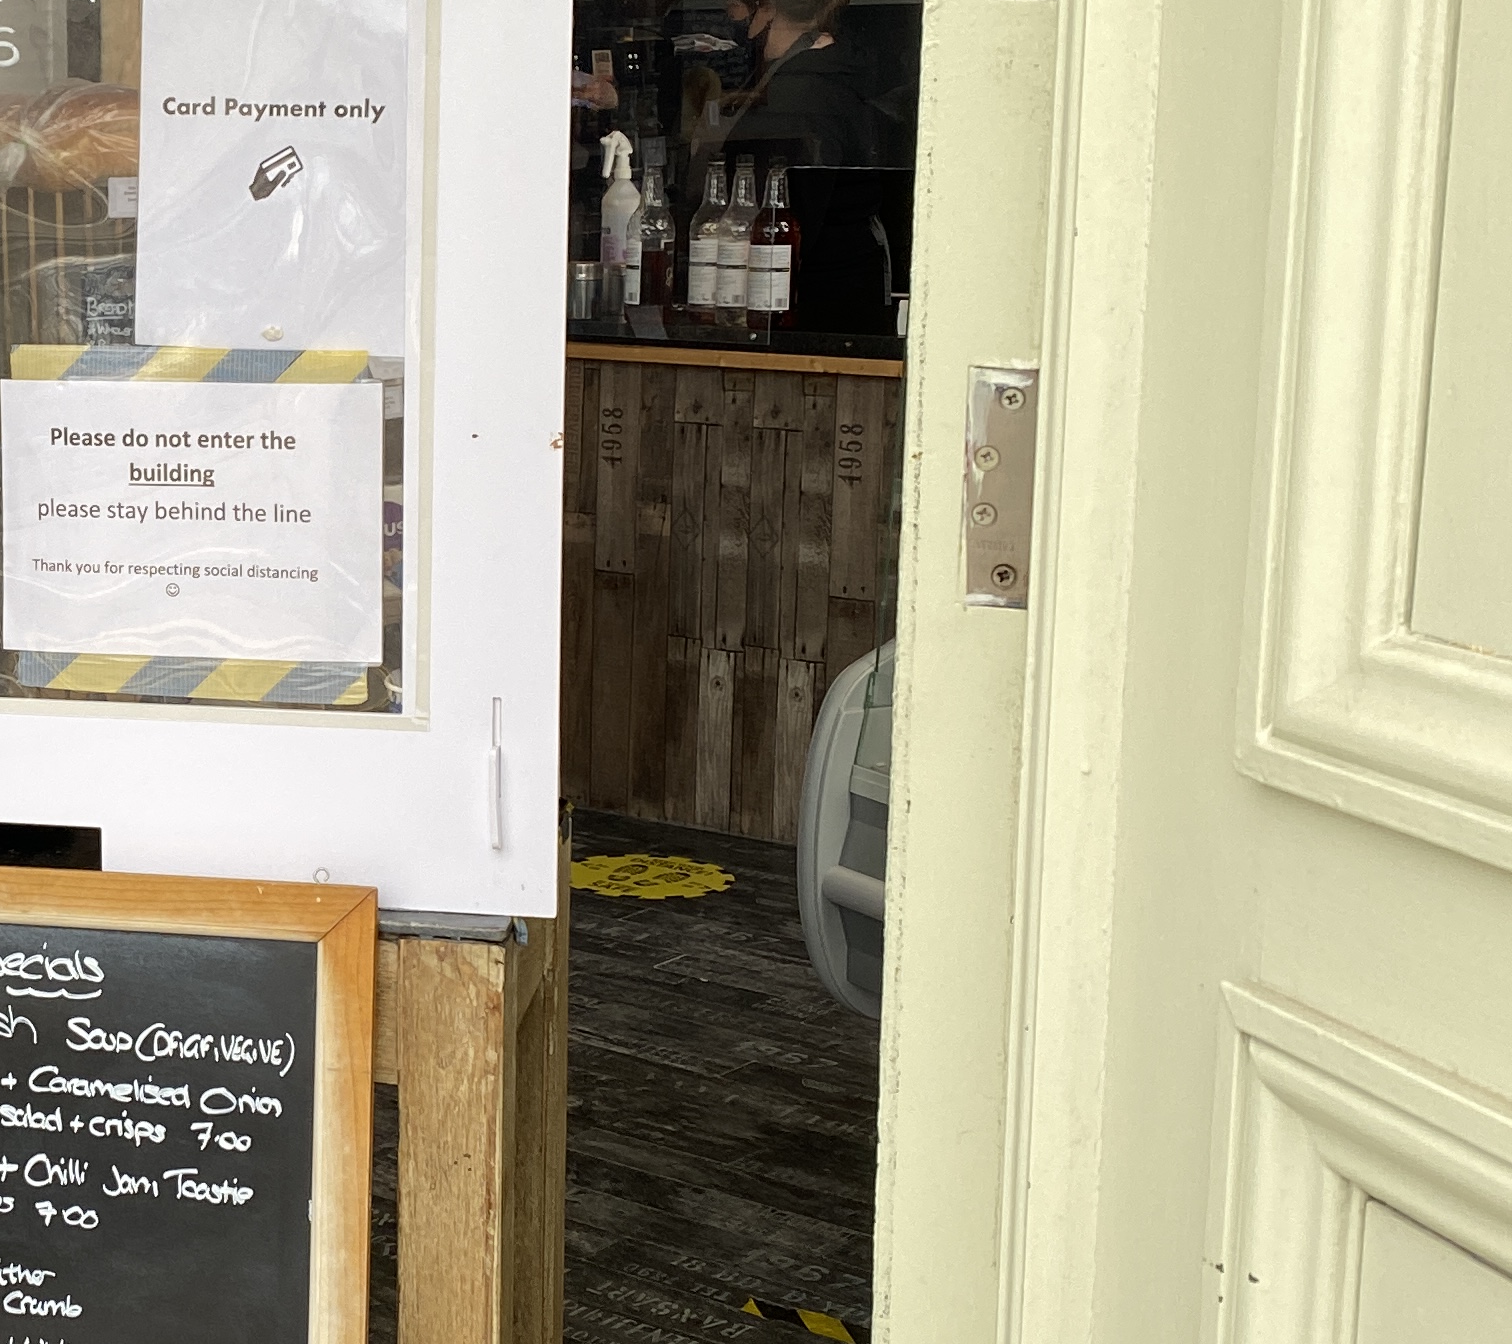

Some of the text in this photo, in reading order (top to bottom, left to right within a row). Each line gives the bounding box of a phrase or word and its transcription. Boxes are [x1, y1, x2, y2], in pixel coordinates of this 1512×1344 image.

[162, 97, 386, 123] Card Payment only
[50, 428, 296, 451] Please do not enter the
[601, 408, 623, 469] 1958
[838, 423, 864, 488] 1958
[129, 463, 215, 487] building
[38, 499, 312, 524] please stay behind the line
[32, 559, 318, 582] Thank you for respecting social distancing
[66, 1017, 133, 1054] Soup
[28, 1065, 190, 1109] Caramelised
[199, 1086, 283, 1117] Onion
[0, 1103, 62, 1133] salad
[88, 1110, 166, 1147] crisps
[190, 1122, 252, 1152] 7.00
[24, 1153, 88, 1187] Chilli
[102, 1165, 158, 1198] Jam
[163, 1168, 254, 1205] Toastie
[3, 1290, 83, 1318] Crumb
